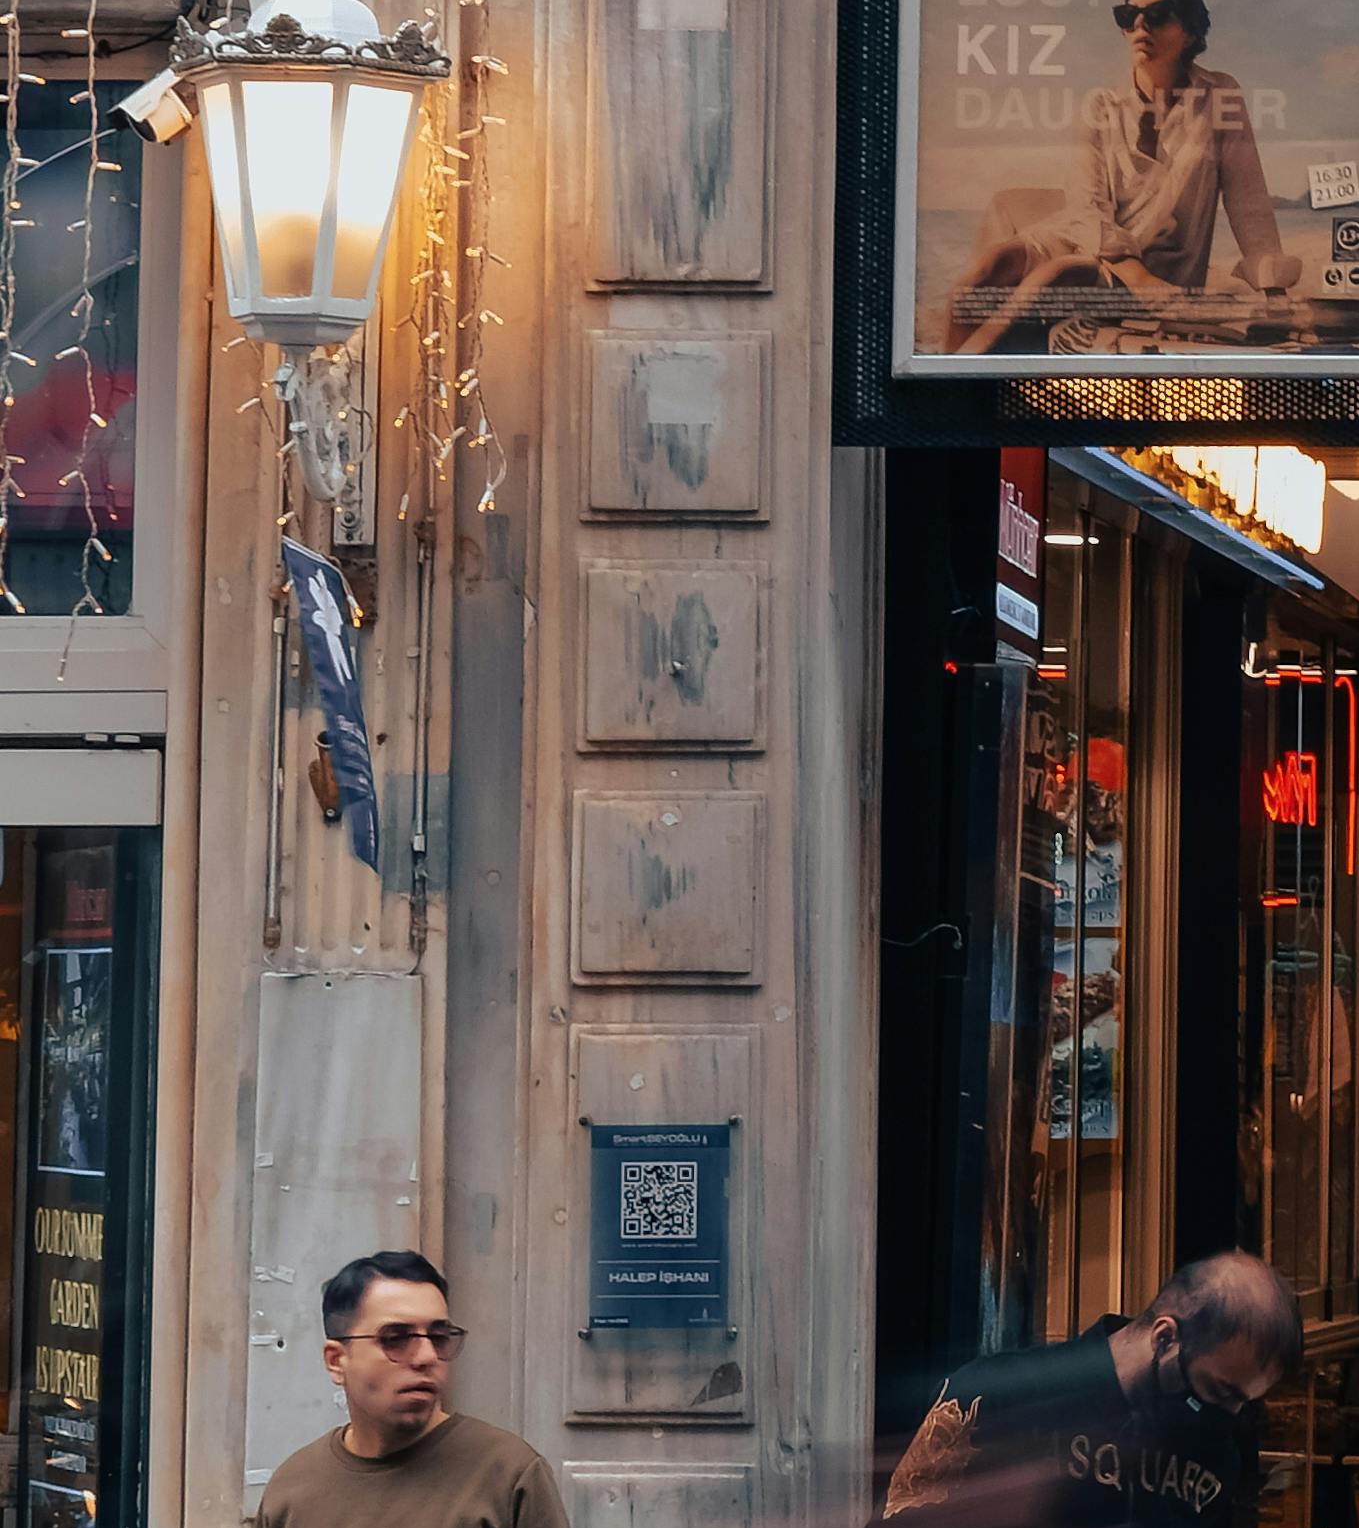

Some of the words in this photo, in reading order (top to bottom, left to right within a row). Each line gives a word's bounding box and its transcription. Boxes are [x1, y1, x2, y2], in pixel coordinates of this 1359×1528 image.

[957, 24, 1067, 76] KIZ
[955, 87, 1288, 131] DAUGHTER
[608, 1271, 657, 1283] HALEP
